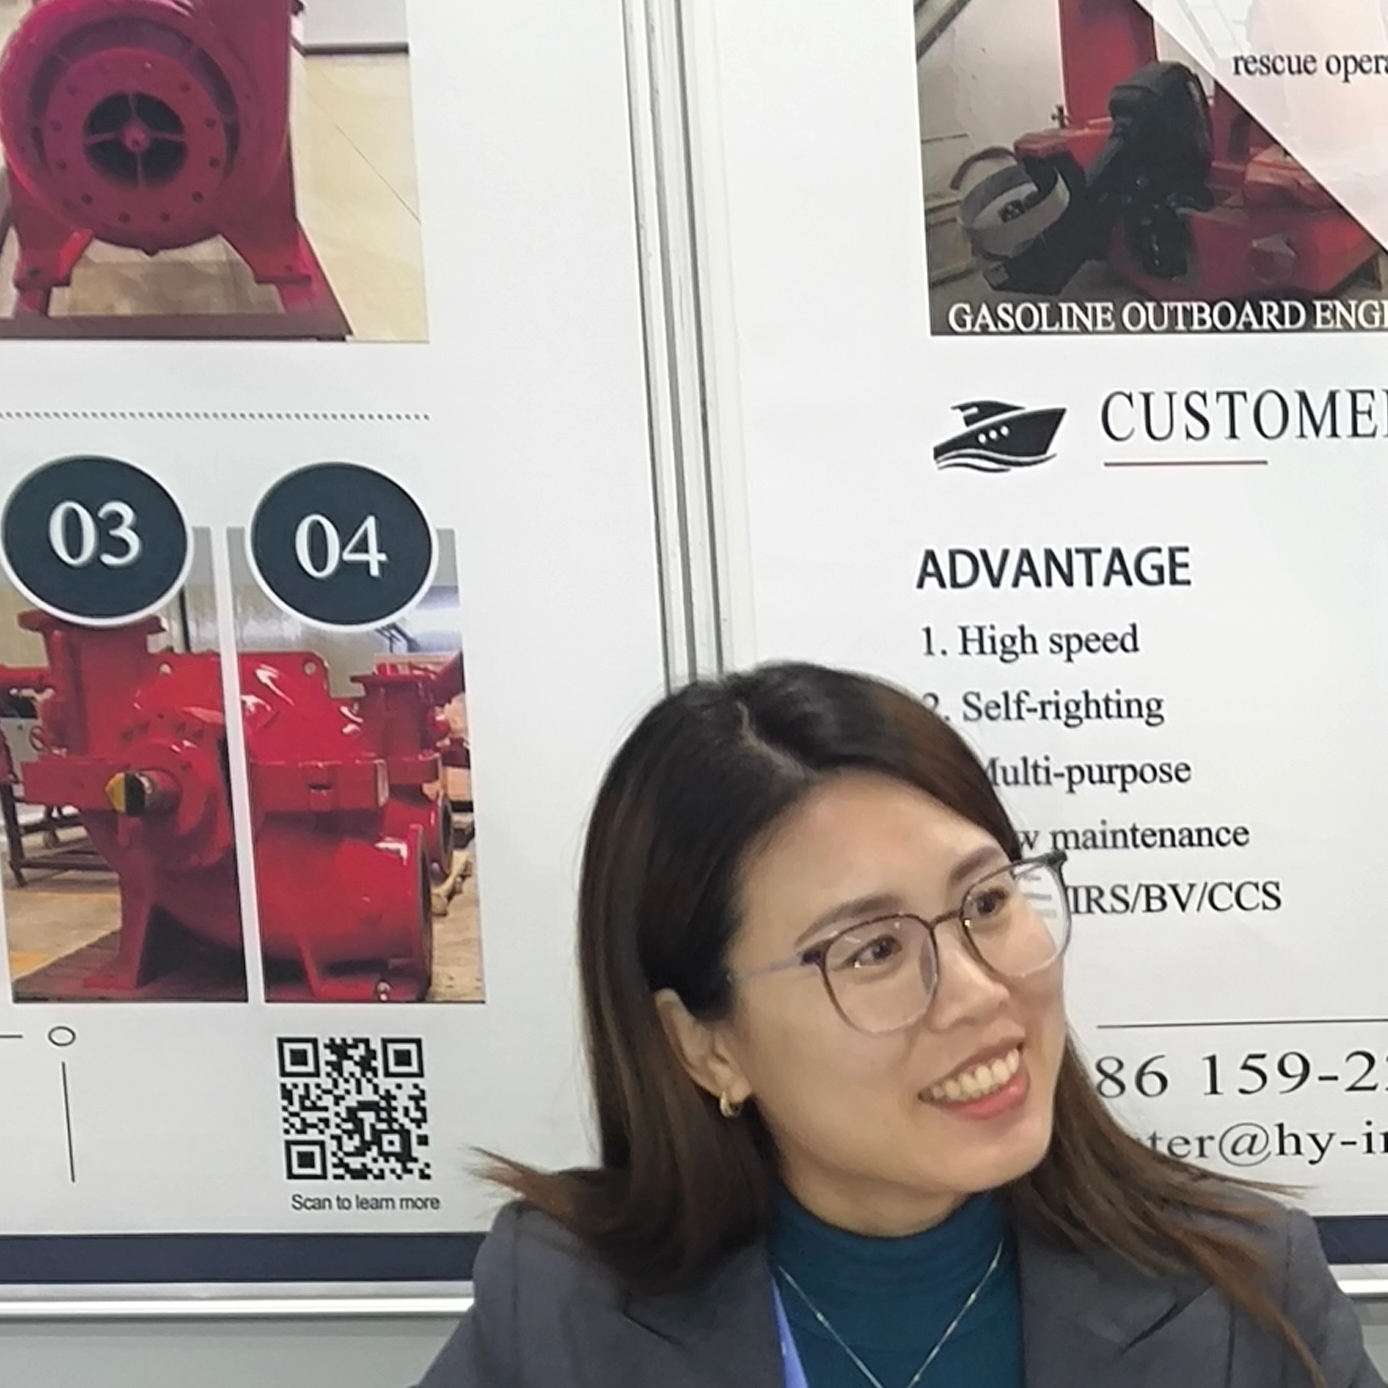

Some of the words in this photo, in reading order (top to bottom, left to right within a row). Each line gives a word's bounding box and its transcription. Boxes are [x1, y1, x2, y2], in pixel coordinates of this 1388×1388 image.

[1232, 53, 1318, 77] rescue
[948, 302, 1116, 333] GASOLINE
[1121, 300, 1308, 331] OUTBOARD
[49, 501, 141, 567] 03
[295, 514, 388, 578] 04
[915, 545, 1192, 590] ADVANTAGE
[921, 625, 948, 658] 1.
[957, 623, 1040, 665] High
[1048, 621, 1141, 664] speed
[961, 687, 1166, 729] Self-righting
[1049, 818, 1250, 852] maintenance
[291, 1193, 333, 1211] Scan
[335, 1194, 353, 1211] to
[354, 1193, 396, 1211] learn
[399, 1195, 441, 1211] more
